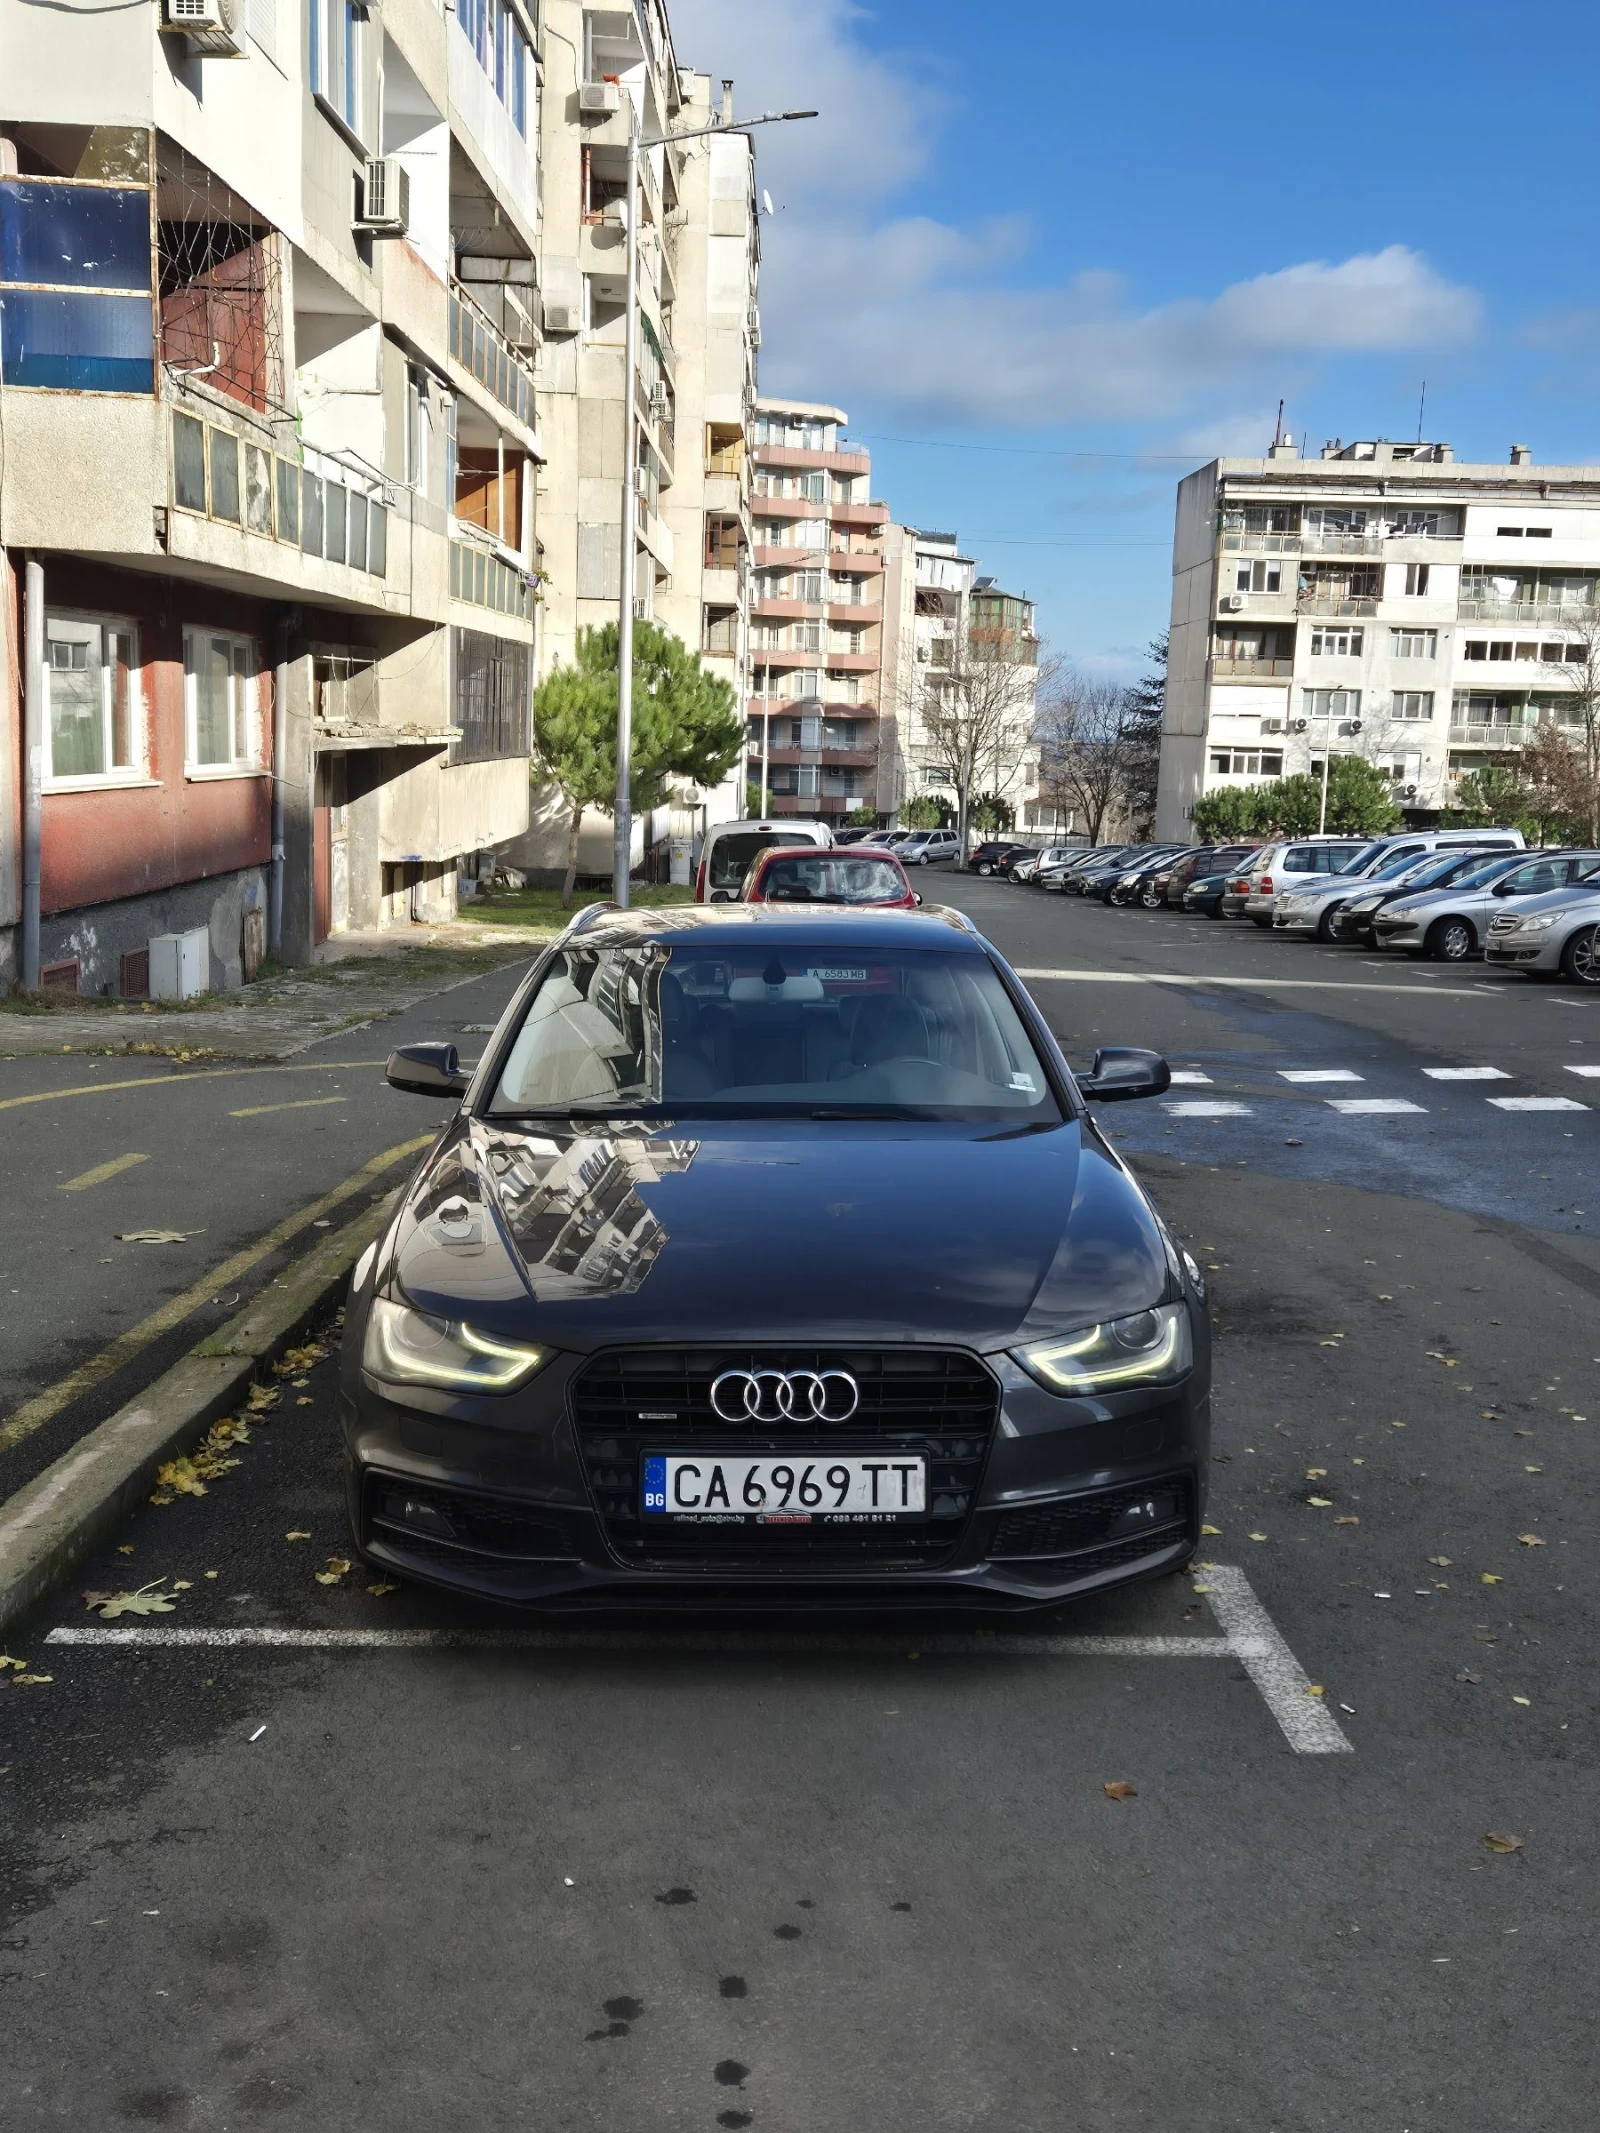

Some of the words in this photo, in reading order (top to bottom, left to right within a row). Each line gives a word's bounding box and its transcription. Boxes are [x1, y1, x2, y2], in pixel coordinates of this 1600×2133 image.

[812, 969, 819, 978] A
[674, 1464, 731, 1508] CA
[742, 1464, 851, 1508] 6969
[861, 1464, 918, 1507] TT
[645, 1493, 664, 1506] BG
